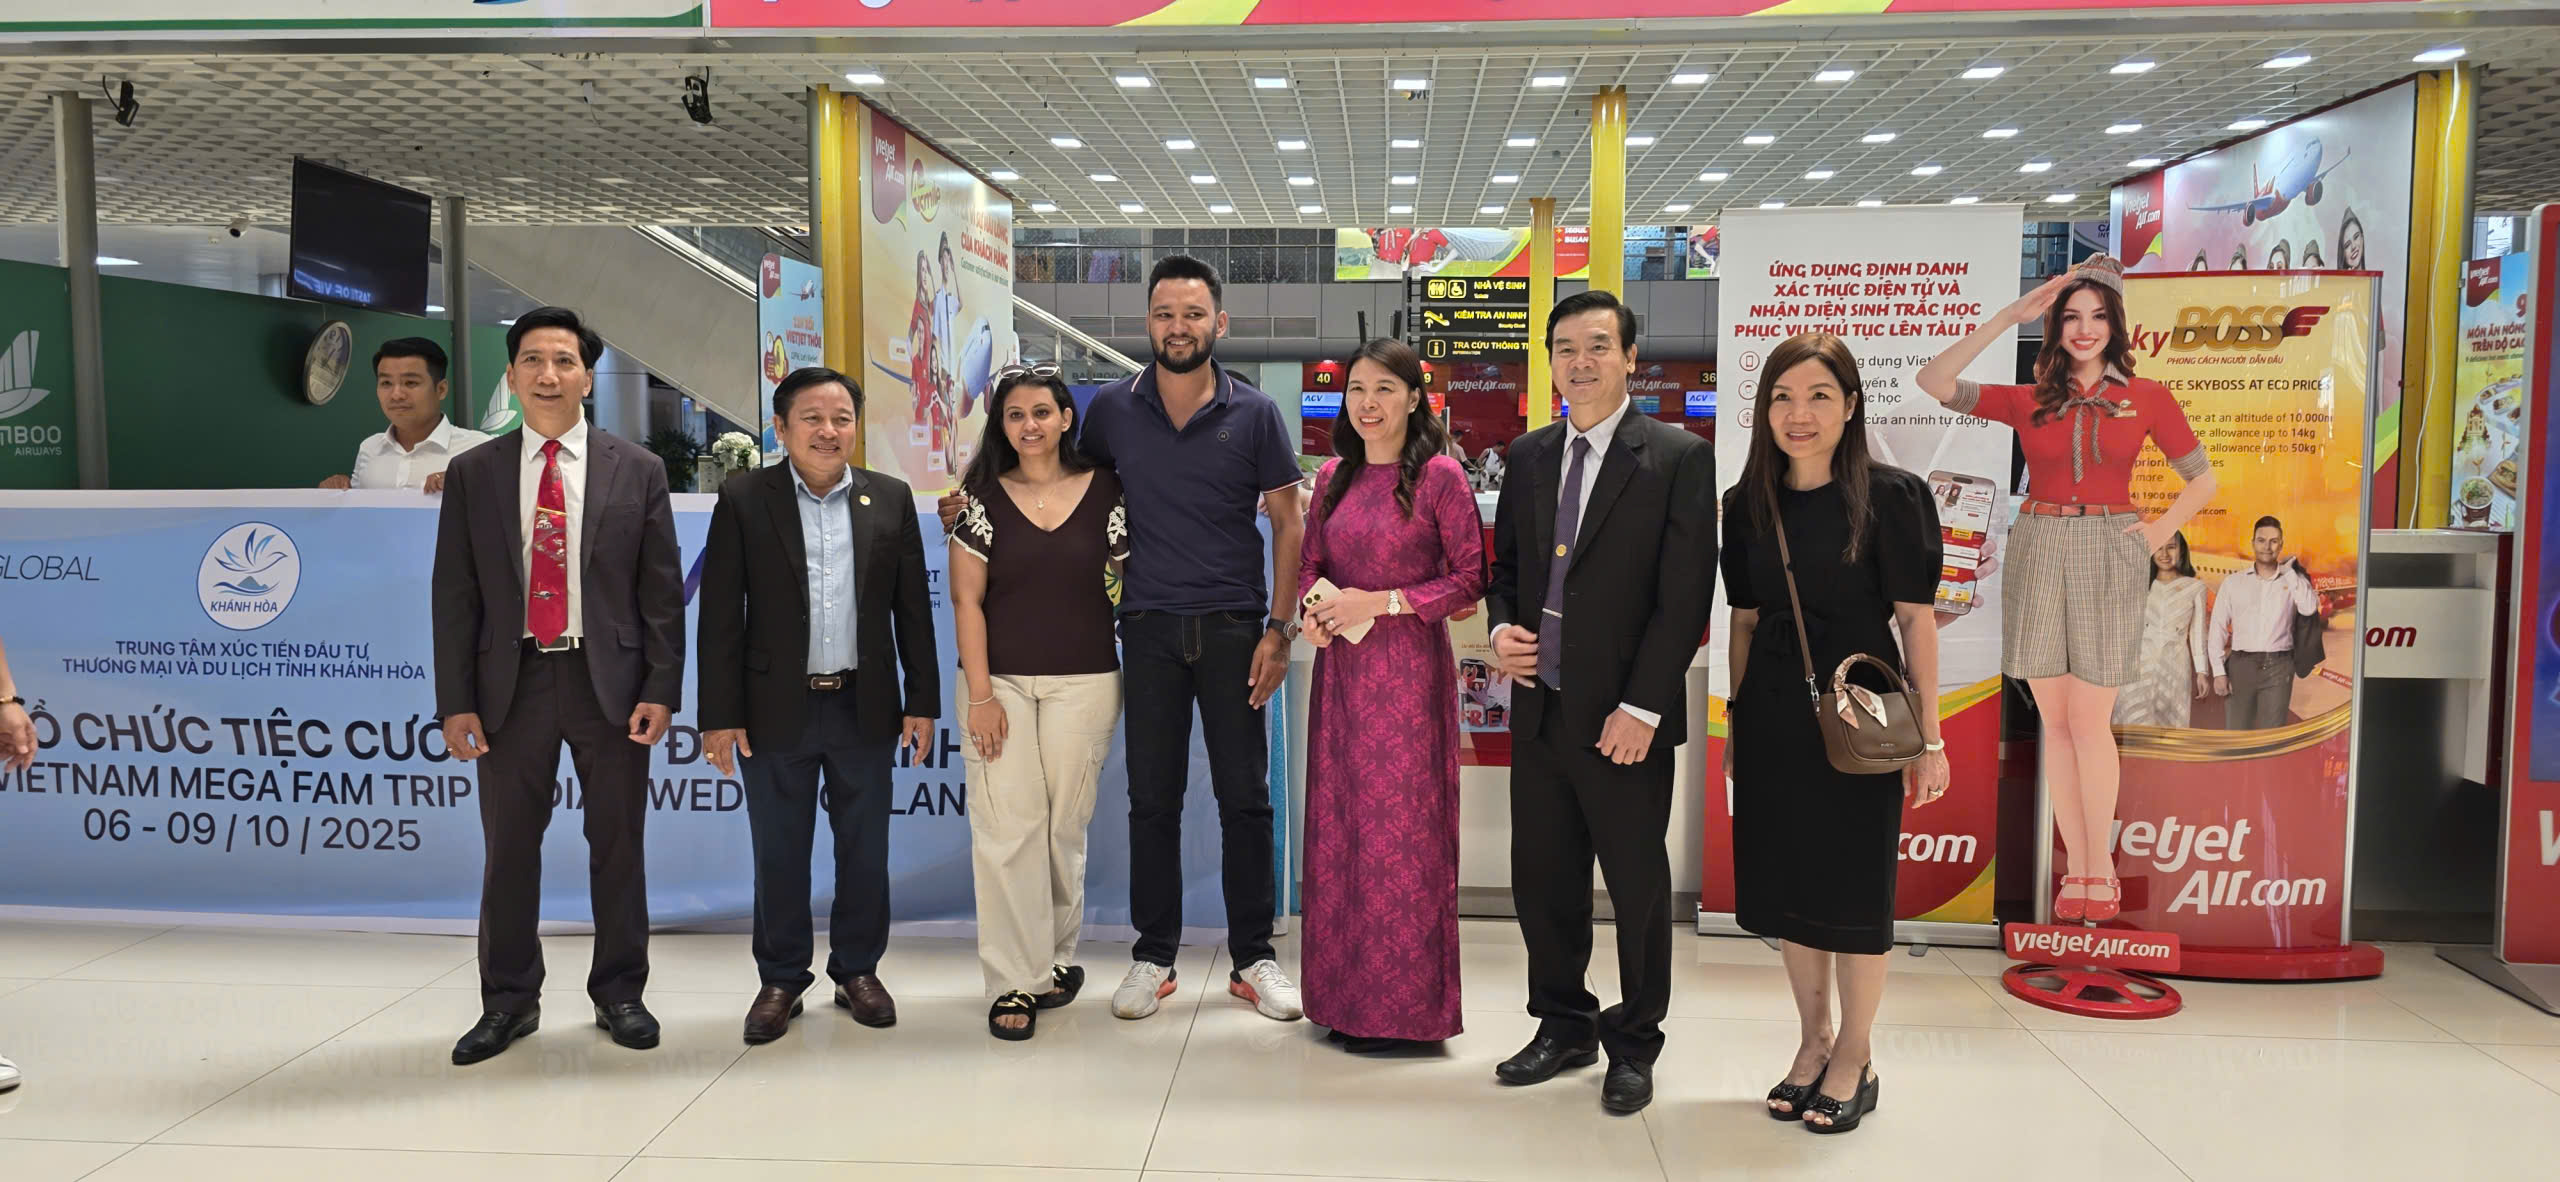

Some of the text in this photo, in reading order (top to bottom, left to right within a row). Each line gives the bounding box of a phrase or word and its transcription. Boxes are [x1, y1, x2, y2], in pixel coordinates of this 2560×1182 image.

[1769, 260, 1969, 280] ỨNG DỤNG ĐỊNH DANH
[1474, 280, 1526, 291] NHÀ VỆ SINH
[1774, 280, 1809, 297] XÁC
[1813, 282, 1860, 300] THỰC
[1864, 279, 1907, 300] ĐIỆN
[1937, 279, 1961, 296] VÀ
[1475, 311, 1493, 319] TRA
[1493, 311, 1505, 319] AN
[1506, 311, 1527, 319] NINH
[1749, 299, 1981, 321] NHẬN DIỆN SINH TRẮC HỌC
[1734, 324, 1781, 341] PHỤC
[1852, 324, 1885, 341] TỤC
[1889, 320, 1923, 336] LÊN
[1927, 320, 1960, 336] TÀU
[1453, 341, 1470, 349] TRA
[1491, 341, 1520, 350] THÔNG
[1868, 355, 1902, 369] dụng
[2167, 357, 2196, 365] PHONG
[2198, 355, 2219, 365] CÁCH
[1317, 373, 1331, 383] 40
[1703, 372, 1716, 383] 36
[2187, 379, 2245, 390] SKYBOSS
[2249, 379, 2264, 390] AT
[2267, 379, 2289, 390] ECO
[1878, 392, 1901, 405] học
[1891, 415, 1906, 425] an
[1909, 414, 1936, 425] ninh
[1939, 414, 1953, 427] tự
[1956, 414, 1989, 428] động
[2204, 414, 2216, 423] at
[2219, 415, 2232, 423] an
[2234, 412, 2273, 423] altitude
[2276, 413, 2287, 423] of
[2209, 428, 2260, 438] allowance
[2263, 430, 2275, 439] up
[2278, 429, 2288, 438] to
[2292, 428, 2316, 439] 14kg
[15, 447, 63, 457] AIRWAYS
[2210, 443, 2316, 454] allowance up to 50kg
[2136, 474, 2164, 482] more
[2143, 491, 2166, 500] 1900
[210, 598, 278, 612] KHÁNH HÒA
[115, 640, 175, 656] TRUNG
[179, 638, 216, 657] TÂM
[220, 638, 258, 657] XÚC
[261, 638, 300, 658] TIẾN
[304, 640, 341, 659] ĐẦU
[63, 657, 136, 674] THƯƠNG
[140, 660, 172, 679] MẠI
[176, 657, 199, 675] VÀ
[203, 661, 227, 676] DU
[231, 662, 271, 680] LỊCH
[320, 660, 383, 679] KHÁNH
[387, 661, 426, 680] HÒA
[73, 704, 213, 754] CHỨC
[220, 707, 333, 768] TIỆC
[171, 766, 282, 801] MEGA
[293, 771, 373, 805] FAM
[384, 774, 472, 807] TRIP
[84, 808, 131, 842] 06
[167, 811, 216, 845] 09
[225, 813, 238, 852] /
[246, 814, 289, 848] 10
[300, 816, 311, 855] /
[320, 816, 421, 852] 2025
[2166, 870, 2327, 915] Air.com
